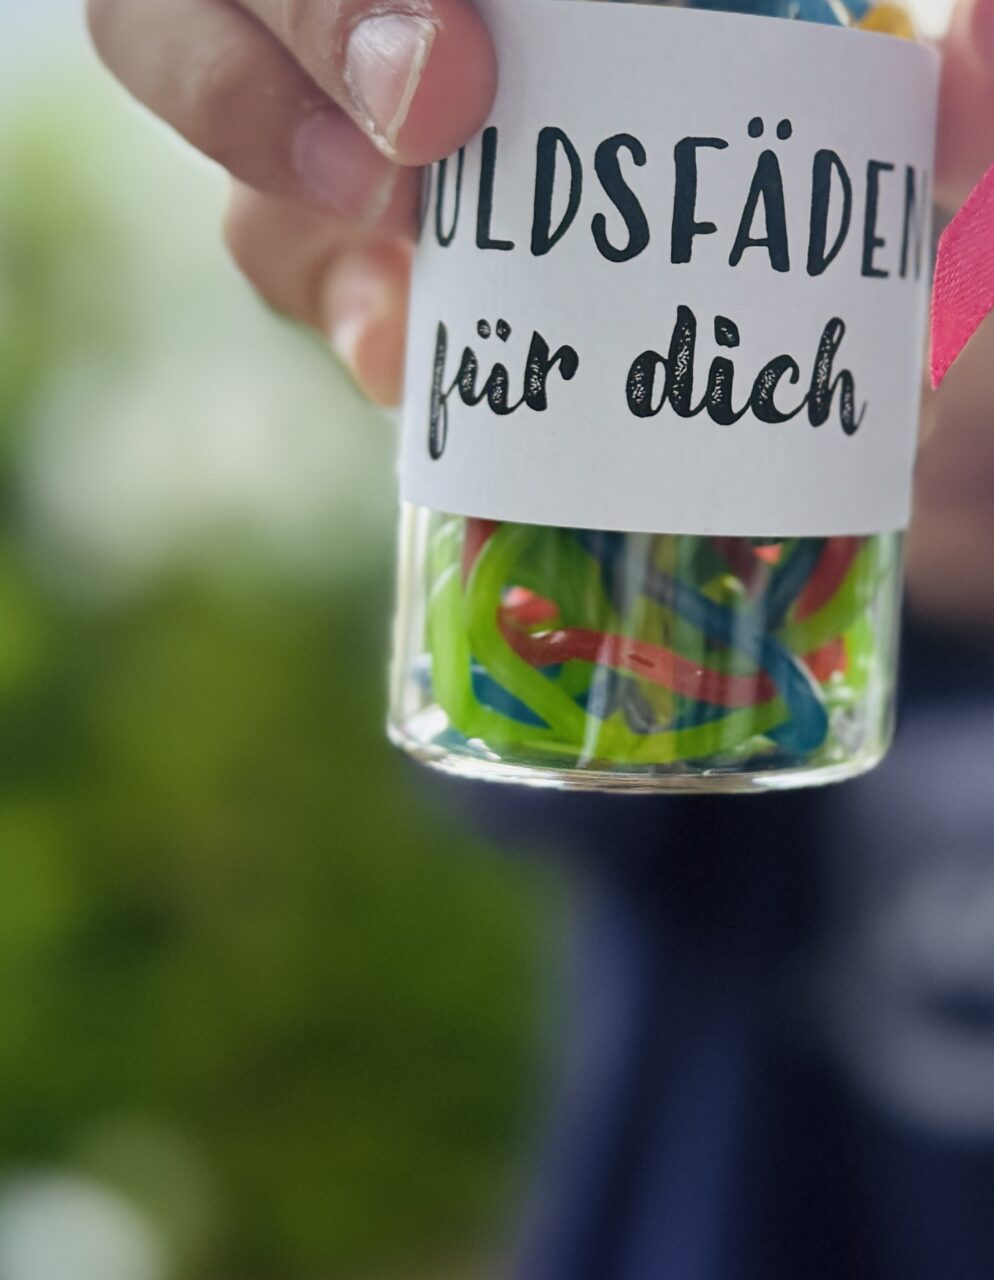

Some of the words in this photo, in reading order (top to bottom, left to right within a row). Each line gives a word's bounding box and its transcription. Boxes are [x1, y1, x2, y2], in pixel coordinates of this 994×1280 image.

[419, 116, 928, 281] ULDSFÄDEN
[429, 319, 579, 460] für
[626, 304, 868, 436] dich
